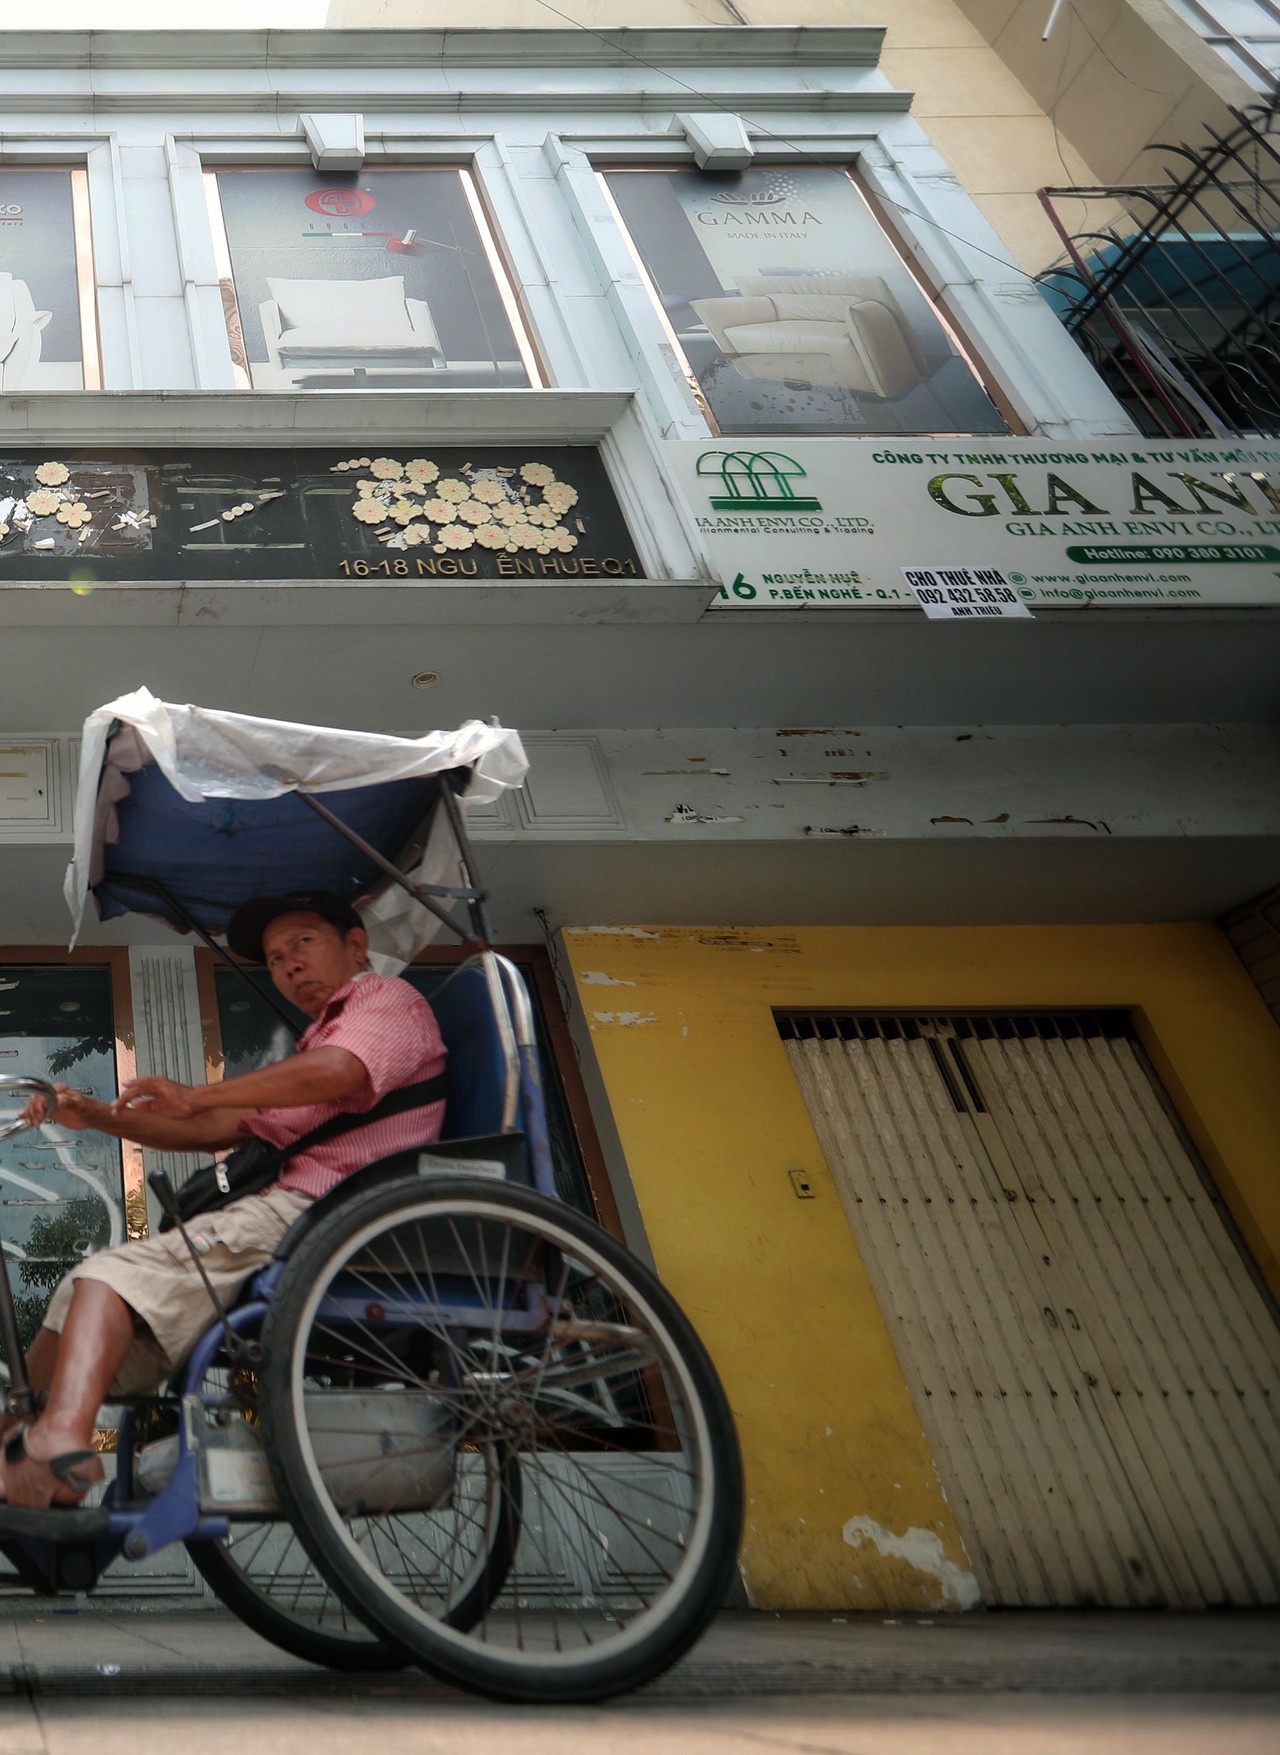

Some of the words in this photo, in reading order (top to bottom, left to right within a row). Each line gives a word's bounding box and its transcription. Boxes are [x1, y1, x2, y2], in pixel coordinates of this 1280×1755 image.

[697, 211, 823, 226] GAMMA
[872, 450, 923, 464] CÔNG
[926, 453, 949, 464] TY
[954, 453, 1008, 464] TNHH
[1007, 453, 1089, 464] THƯƠNG
[1091, 452, 1129, 466] MẠI
[1131, 452, 1148, 463] &
[1146, 451, 1174, 463] TƯ
[1176, 448, 1219, 463] VẤN
[927, 472, 1110, 517] GIA
[716, 517, 754, 527] ANH
[756, 517, 797, 527] ENVI
[834, 517, 875, 527] LTD.
[1005, 522, 1057, 536] GIA
[1061, 522, 1120, 536] ANH
[1122, 521, 1193, 536] ENVI
[1196, 521, 1253, 537] CO.,
[1083, 548, 1151, 560] Hotline:
[1151, 547, 1185, 559] 090
[1223, 547, 1266, 559] 3101
[340, 558, 408, 576] 16-18
[543, 557, 599, 575] HUE
[601, 557, 637, 575] Q1
[905, 571, 938, 587] CHO
[935, 568, 976, 586] THUÊ
[973, 568, 1008, 586] NHÀ
[1031, 572, 1192, 584] www.giaanhenvi.com
[769, 585, 816, 600] P.BẾN
[818, 586, 863, 600] NGHÉ
[876, 589, 901, 600] Q.1
[916, 588, 948, 604] 092
[946, 588, 977, 603] 432
[974, 587, 1018, 603] 58.58
[950, 607, 974, 616] ANH
